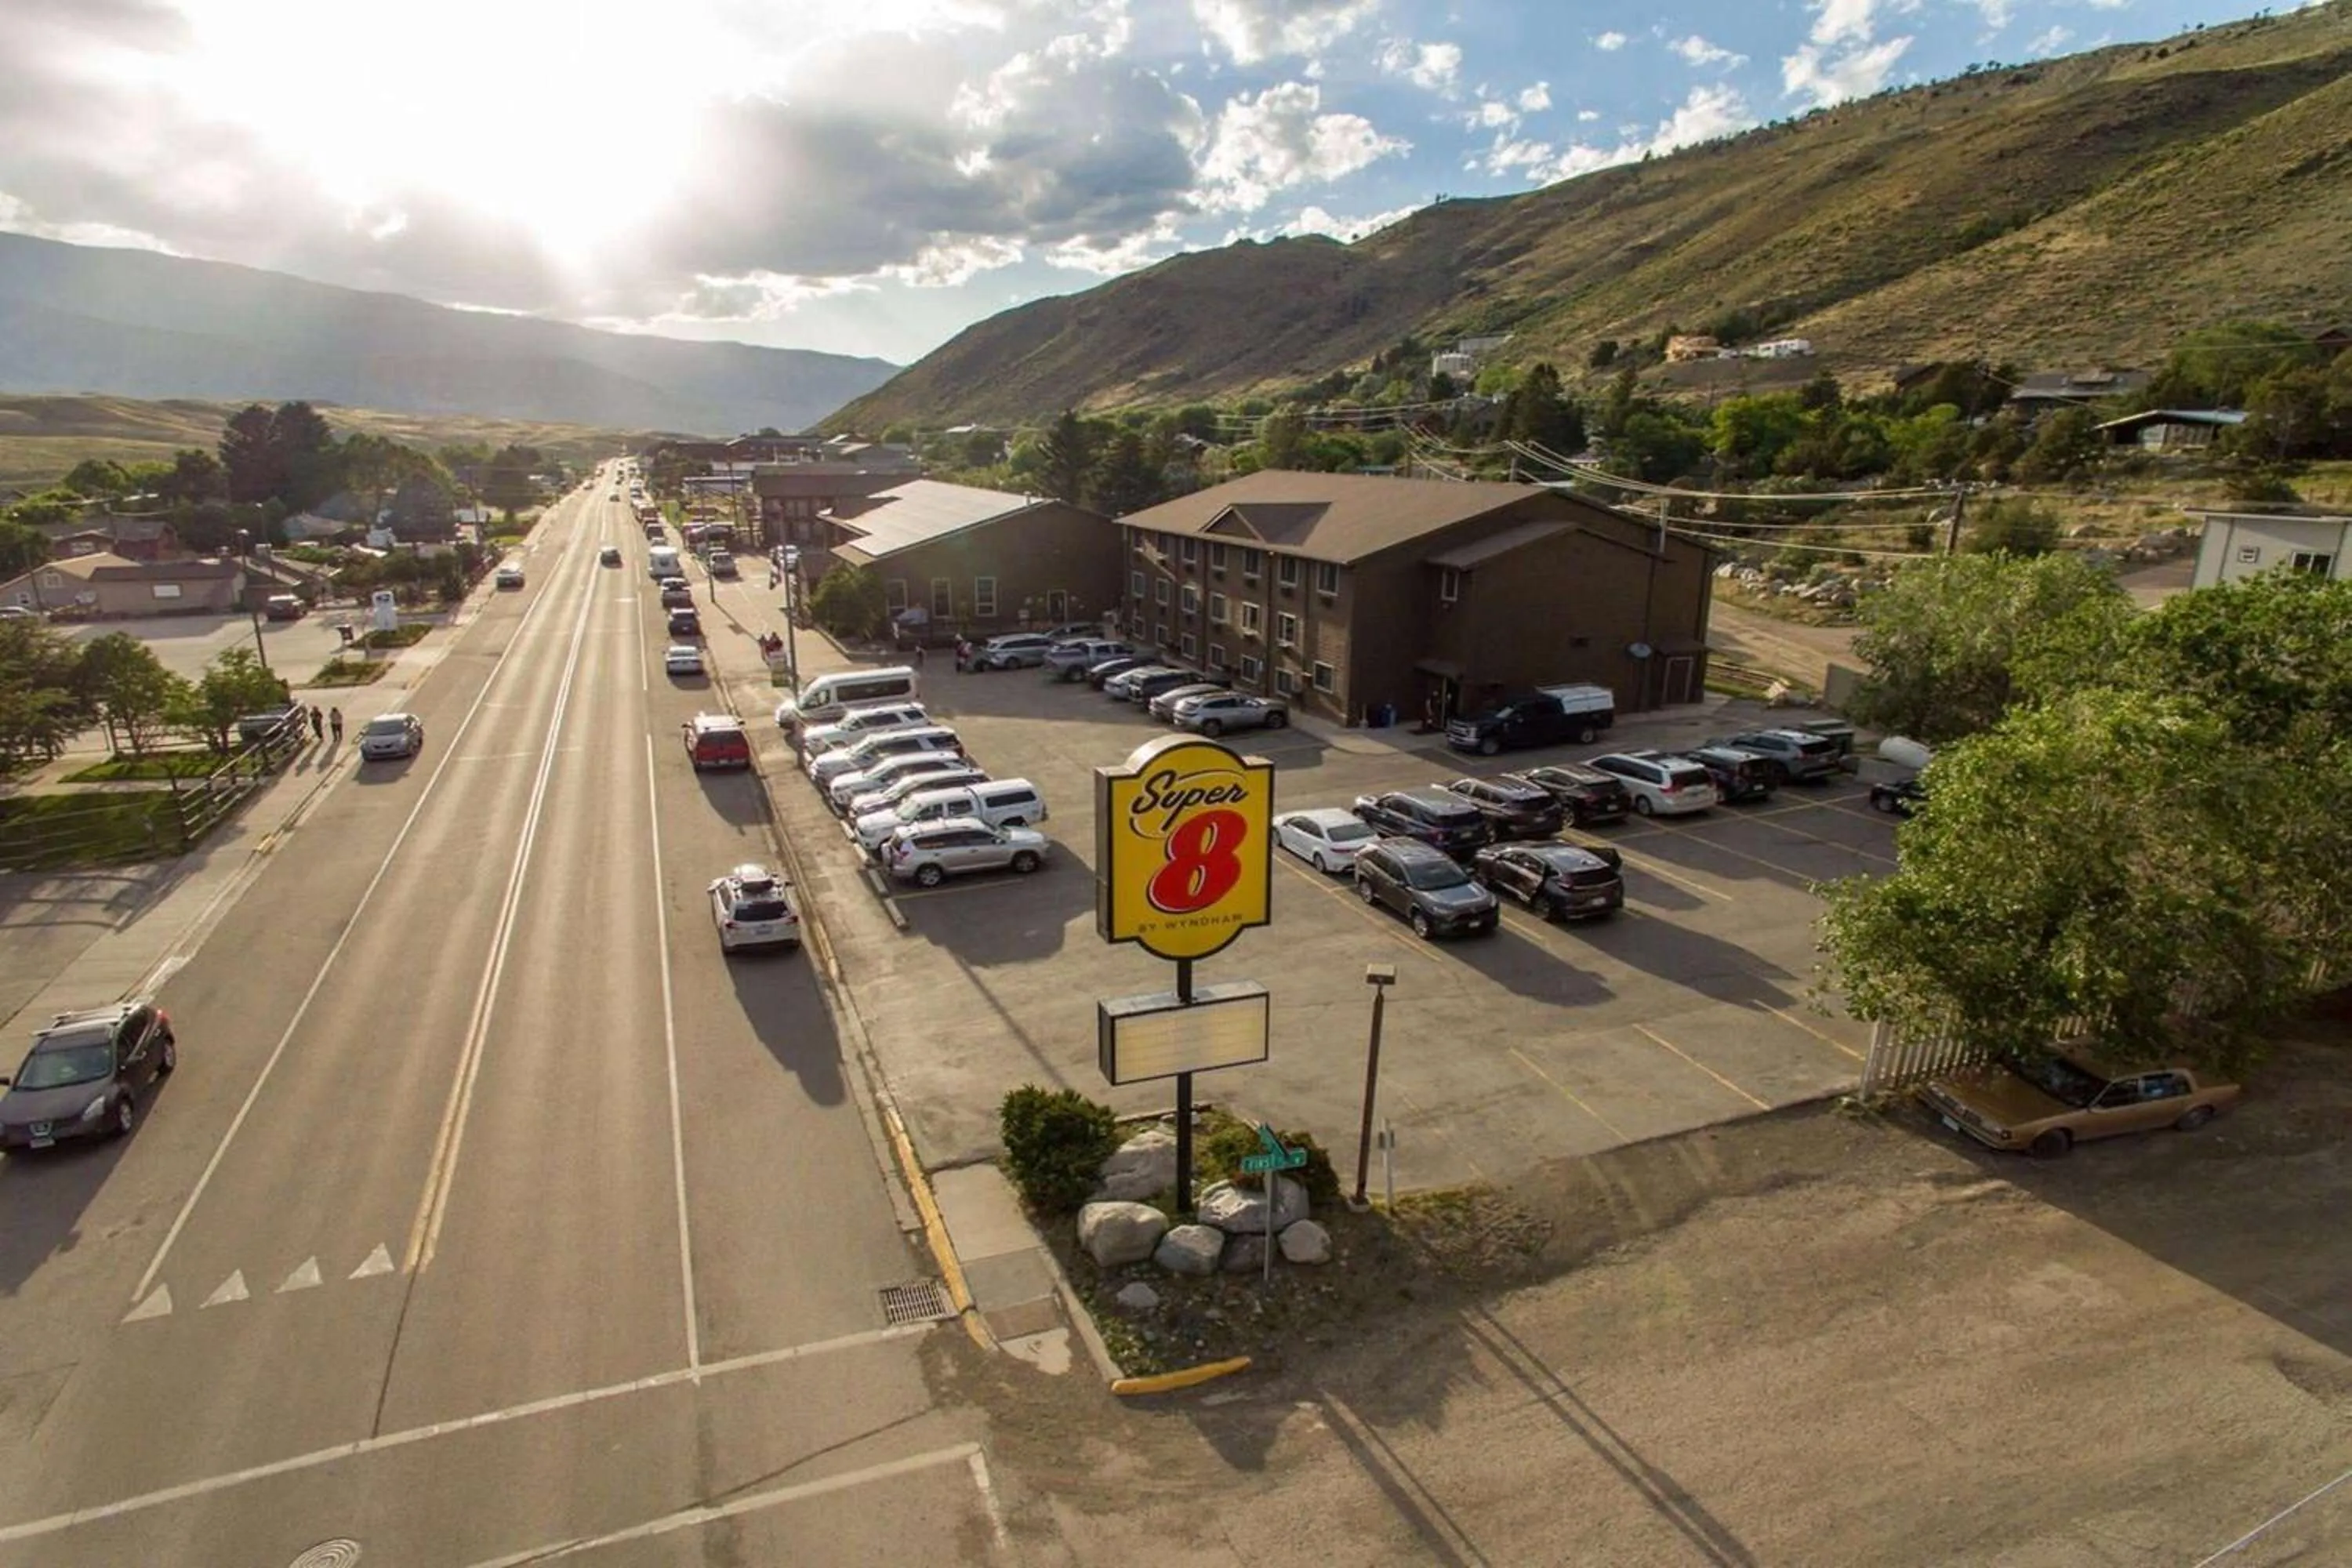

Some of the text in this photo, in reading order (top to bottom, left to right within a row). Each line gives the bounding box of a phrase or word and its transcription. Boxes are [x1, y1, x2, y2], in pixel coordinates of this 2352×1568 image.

[1131, 769, 1248, 832] Super
[1146, 809, 1248, 914] 8
[1138, 913, 1243, 933] BY WYNDHAM
